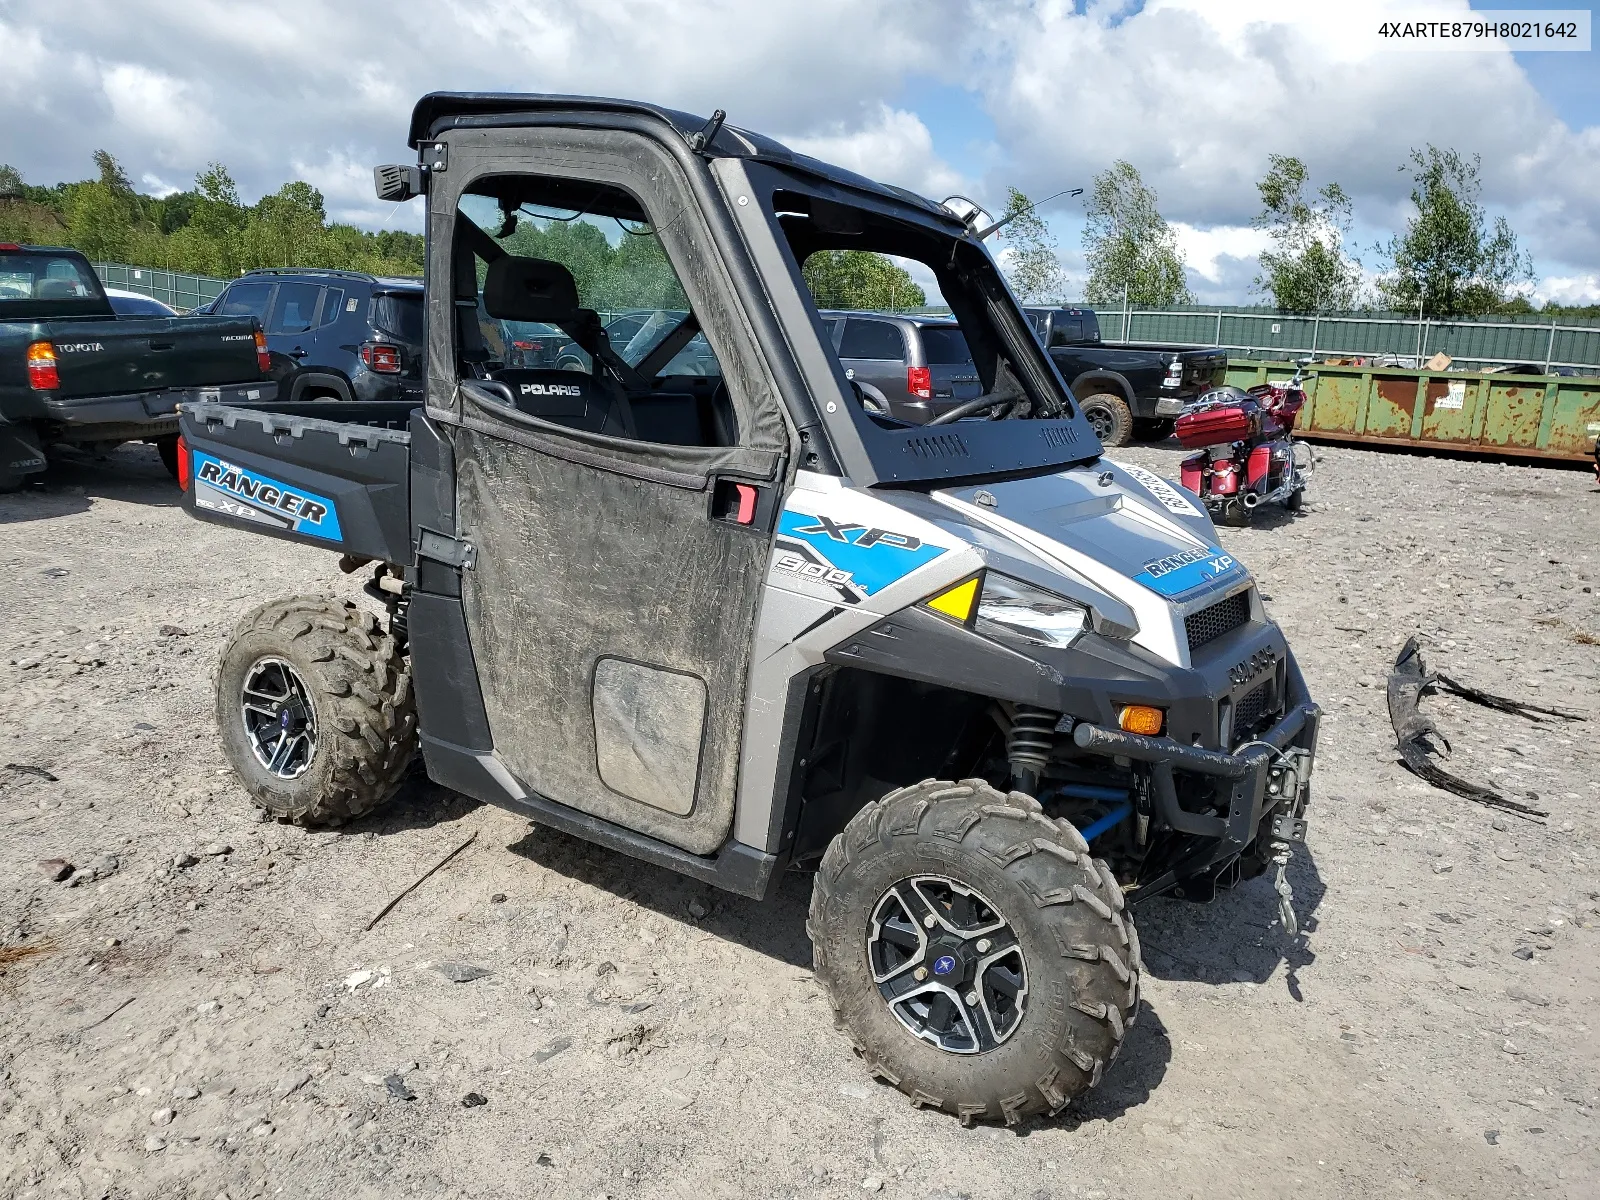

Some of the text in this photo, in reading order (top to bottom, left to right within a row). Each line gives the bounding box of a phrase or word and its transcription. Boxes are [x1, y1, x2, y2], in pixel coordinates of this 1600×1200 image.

[56, 342, 105, 353] TOYOTA
[221, 334, 254, 342] TACOMA
[520, 383, 581, 397] POLARIS
[198, 460, 328, 525] RANGER
[214, 499, 257, 518] XP
[791, 514, 923, 552] XP
[775, 555, 856, 585] 900
[1143, 547, 1214, 579] RANGER
[1207, 554, 1233, 575] XP
